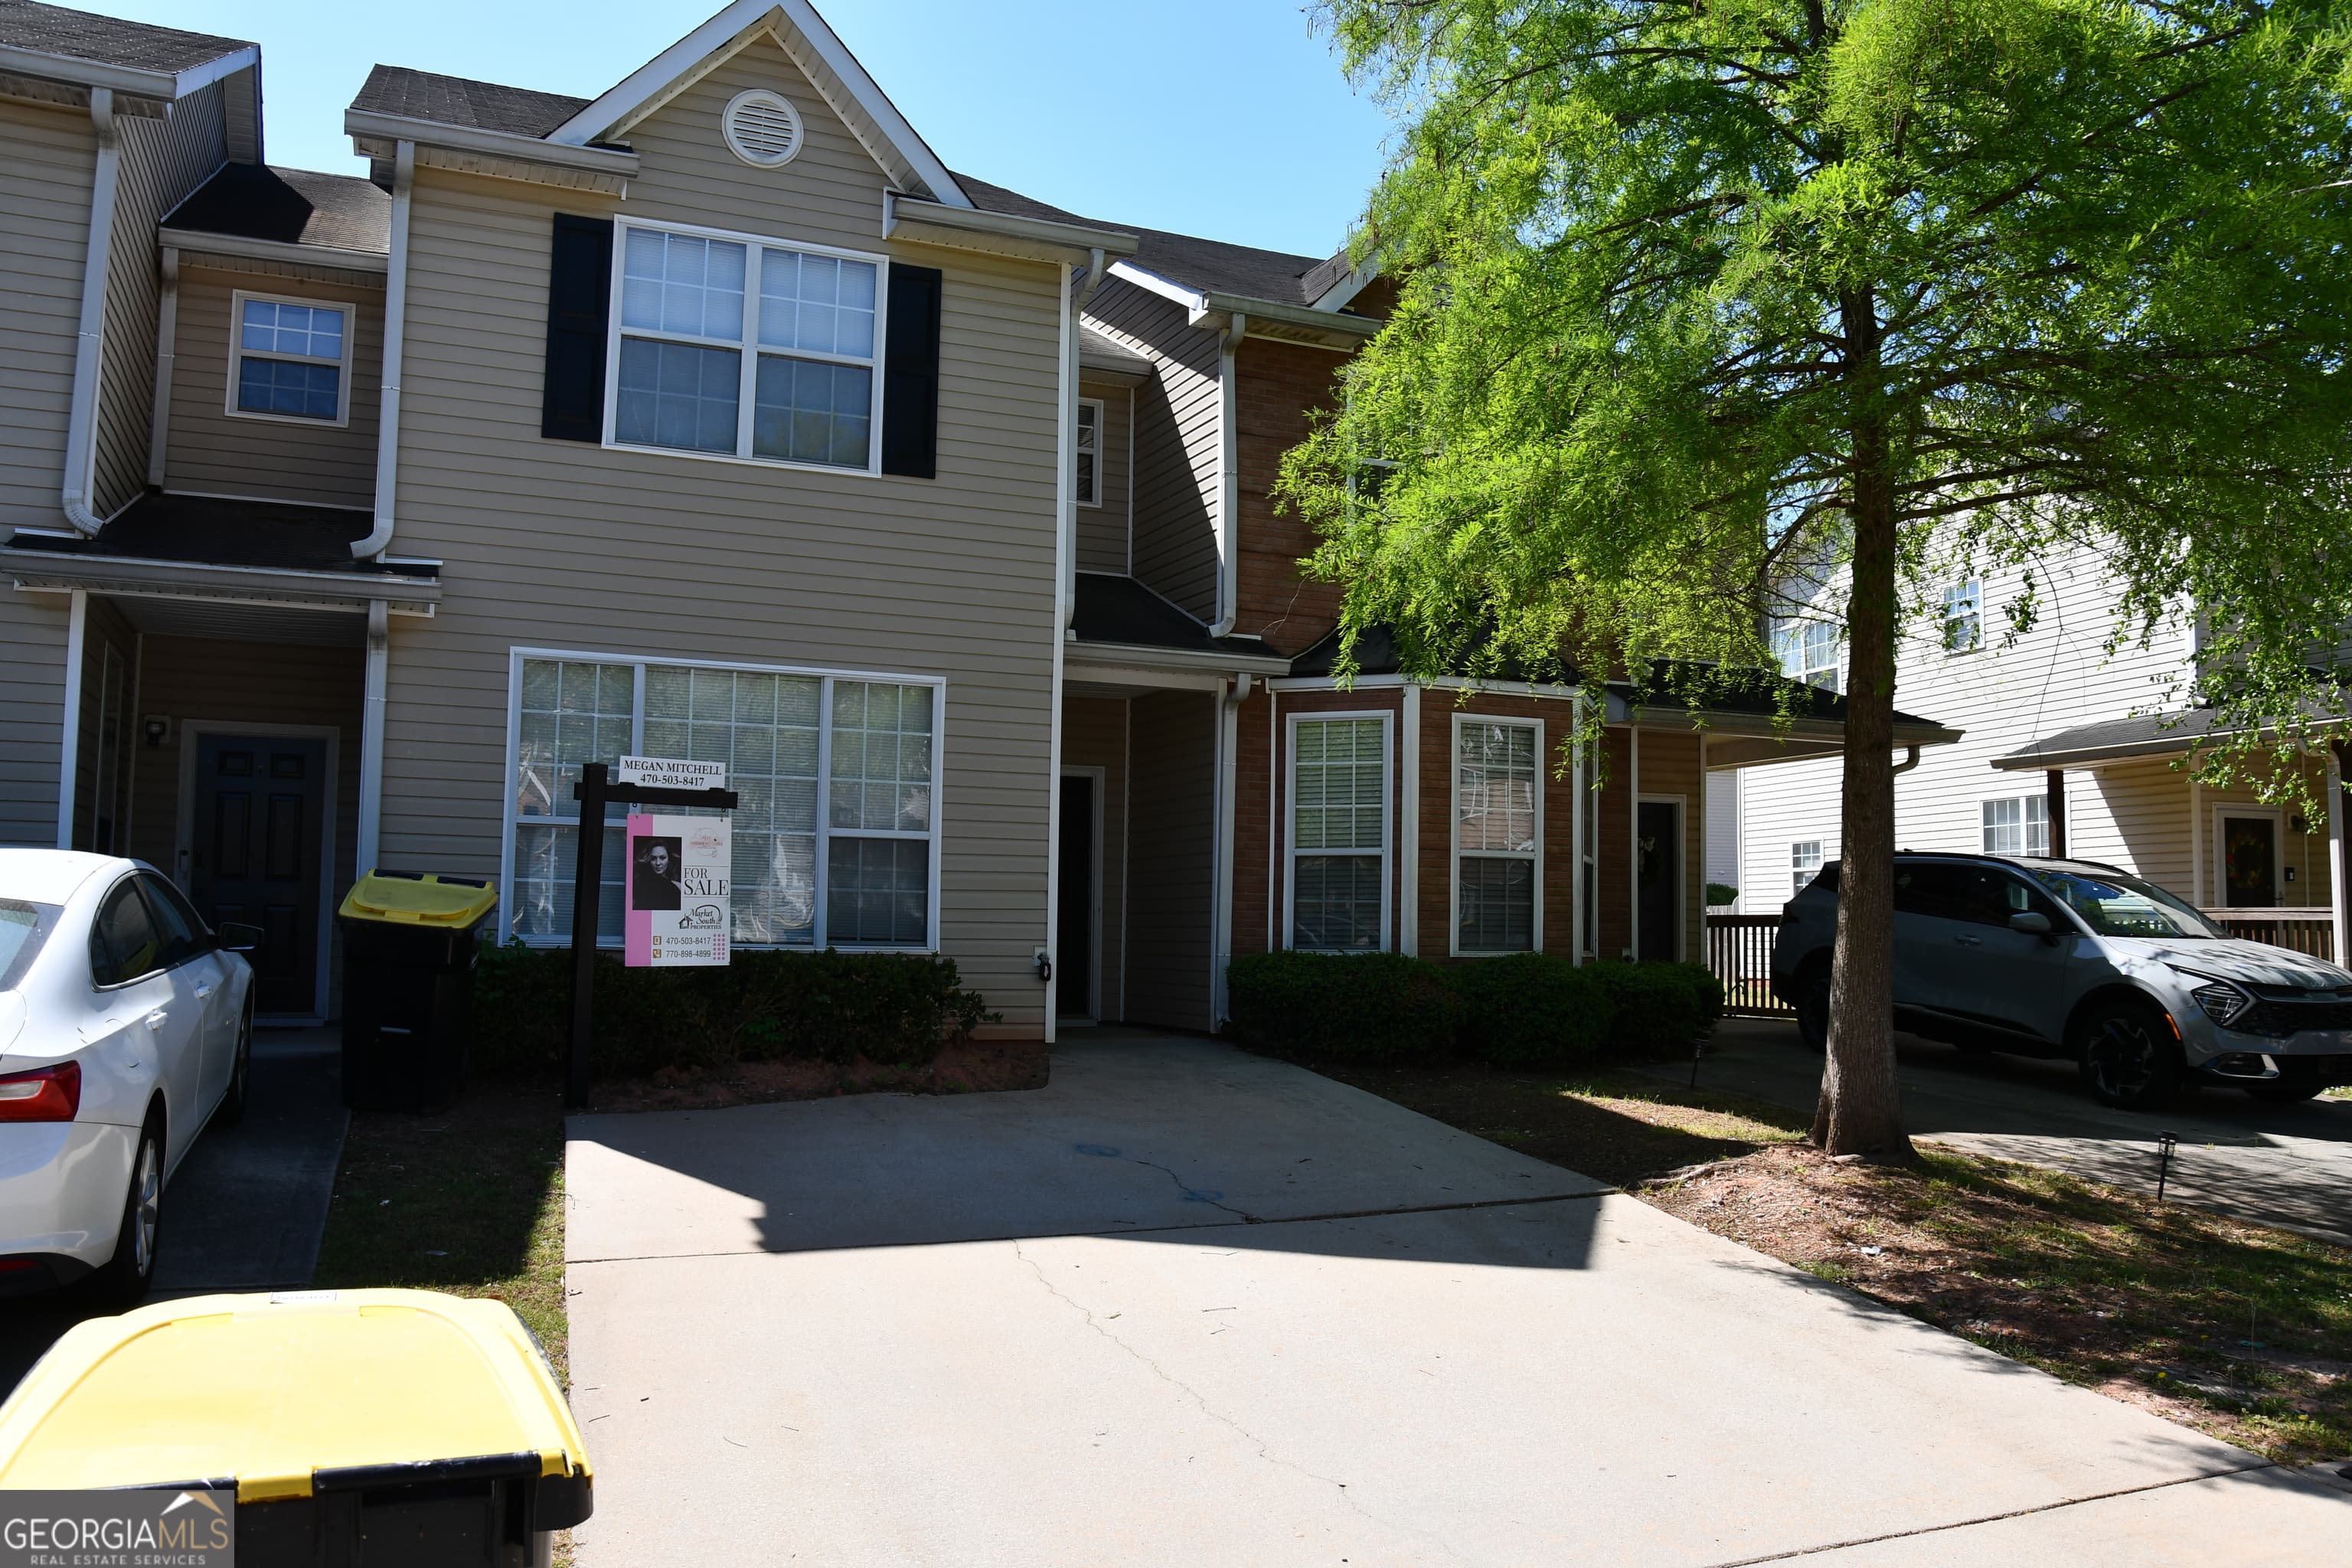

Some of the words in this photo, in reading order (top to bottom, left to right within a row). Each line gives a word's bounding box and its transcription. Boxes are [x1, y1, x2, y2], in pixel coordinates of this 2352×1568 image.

[624, 760, 664, 772] MEGAN
[667, 763, 722, 776] MITCHELL
[640, 773, 704, 786] 470-503-8417
[684, 867, 708, 879] FOR
[684, 879, 729, 896] SALE
[689, 909, 714, 918] Market
[696, 916, 716, 925] South
[666, 936, 711, 945] 470-503-8417
[666, 949, 711, 958] 770-898-4899
